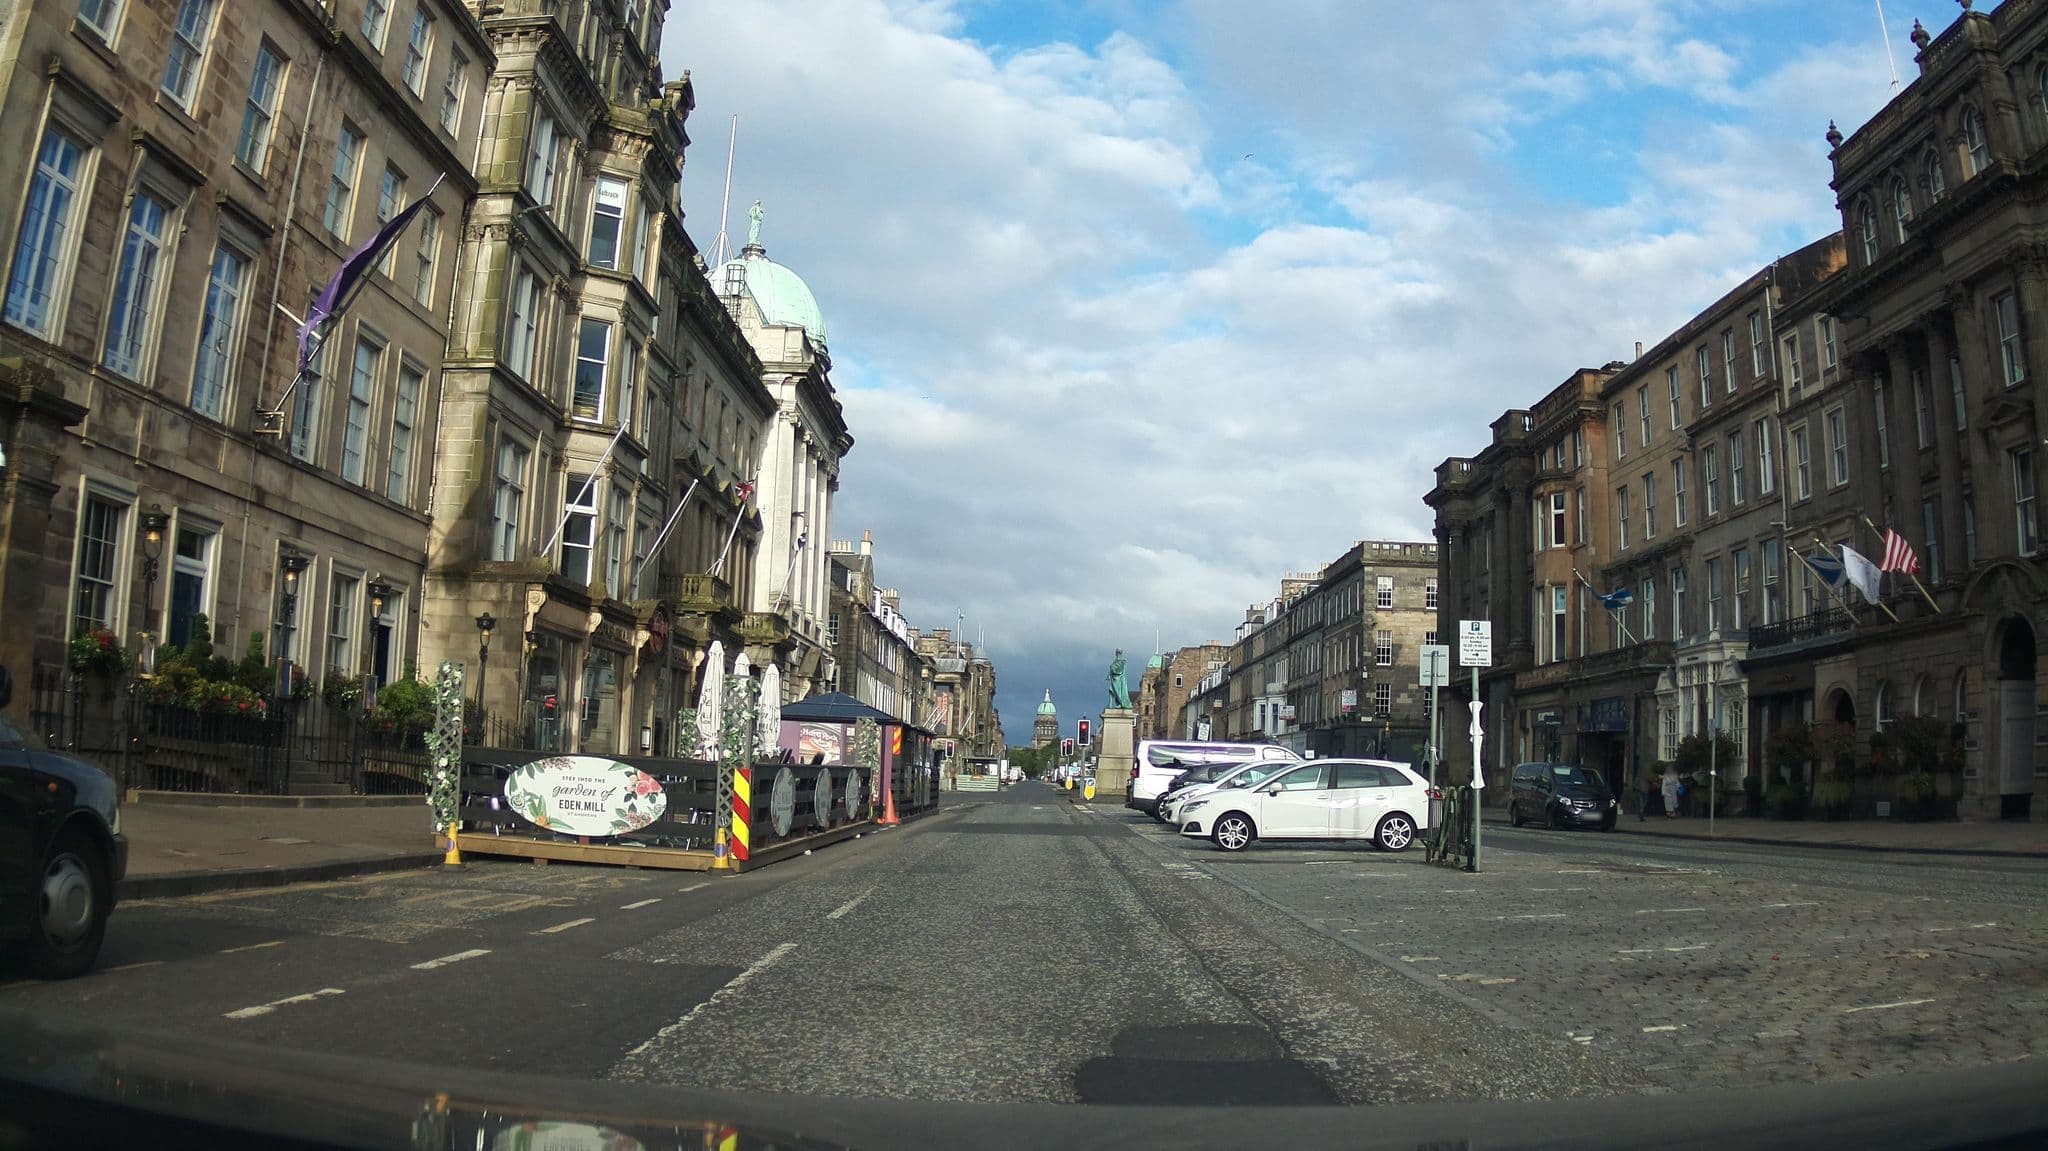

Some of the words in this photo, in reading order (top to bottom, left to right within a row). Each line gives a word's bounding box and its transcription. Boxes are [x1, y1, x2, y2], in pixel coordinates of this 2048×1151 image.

[822, 732, 838, 742] Rock
[551, 783, 597, 798] garden
[600, 786, 617, 802] of
